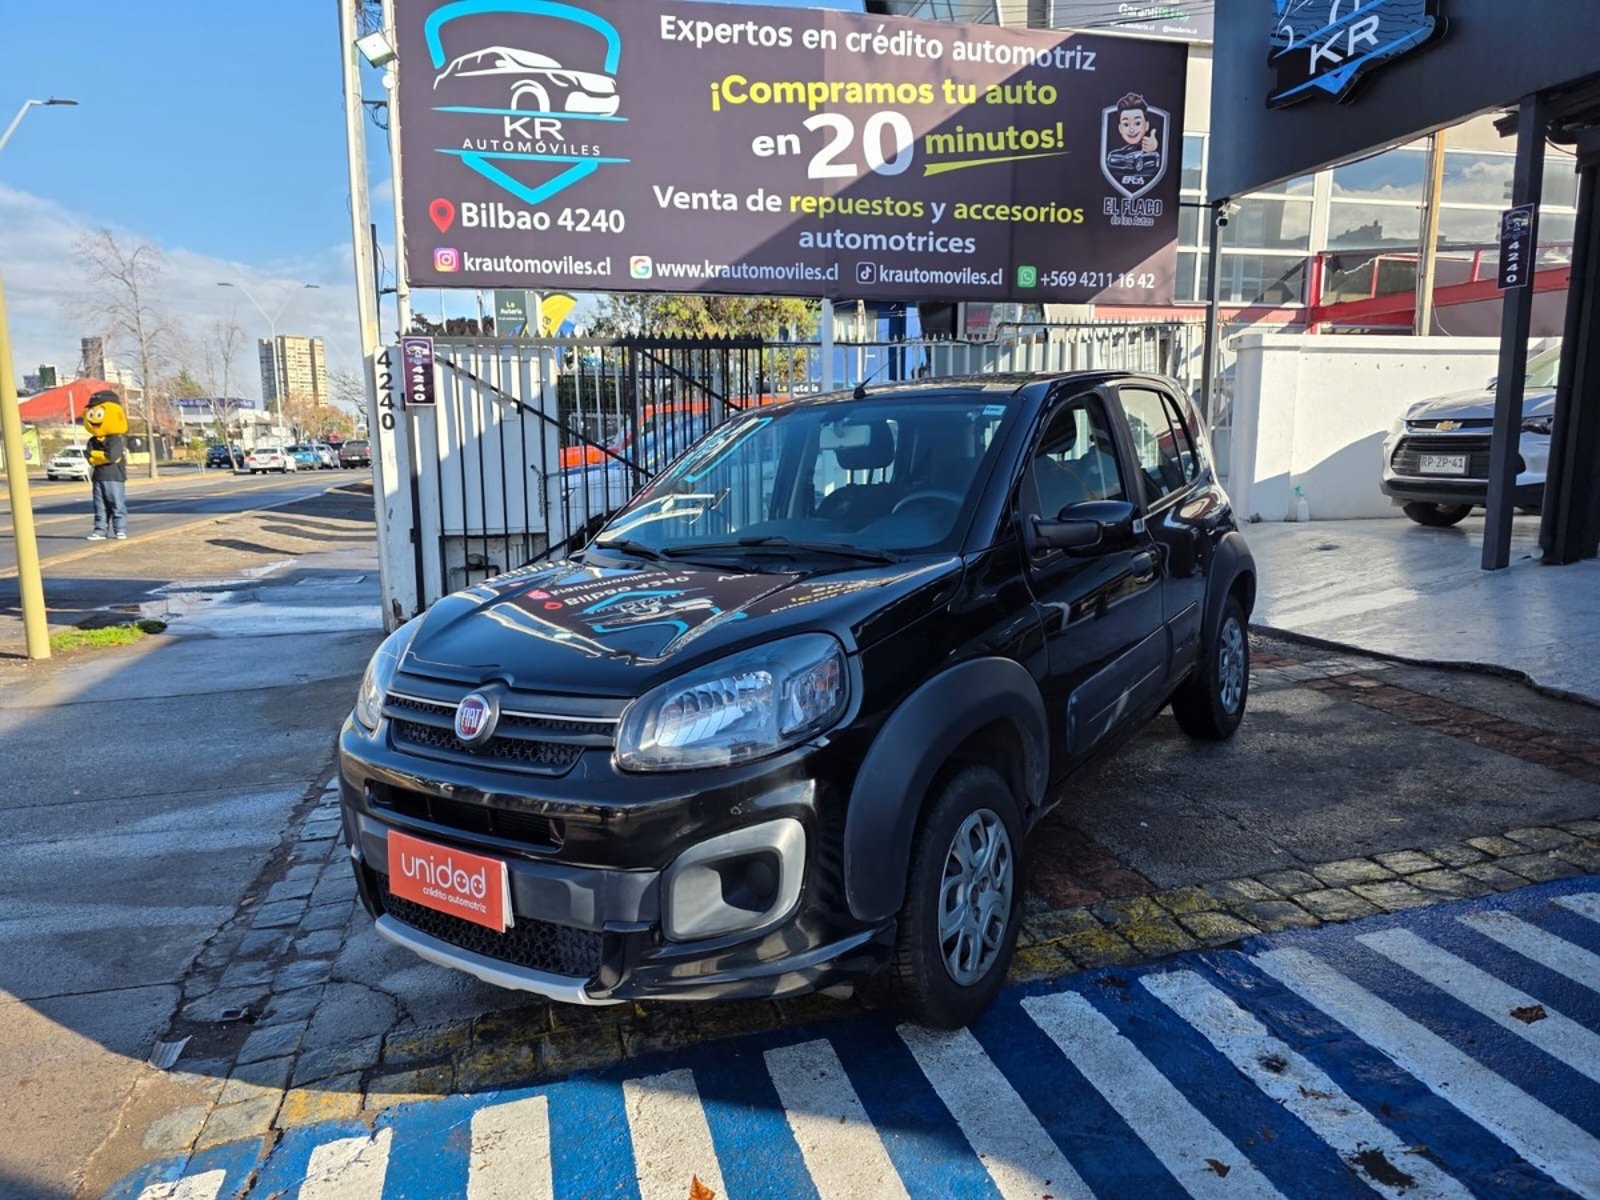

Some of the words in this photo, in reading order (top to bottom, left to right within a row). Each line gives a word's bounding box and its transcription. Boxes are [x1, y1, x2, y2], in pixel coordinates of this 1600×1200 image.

[660, 15, 793, 48] Expertos
[802, 28, 837, 50] en
[845, 24, 944, 59] crédito
[952, 40, 1097, 71] automotriz
[1309, 15, 1380, 75] KR
[710, 74, 935, 111] ¡Compramos
[942, 78, 977, 104] tu
[985, 80, 1057, 105] auto
[503, 116, 565, 141] KR
[462, 138, 601, 156] AUTOMÓVILES
[751, 133, 801, 156] en
[802, 110, 915, 179] 20
[925, 122, 1065, 154] minutos!
[461, 202, 551, 230] Bilbao
[557, 207, 626, 233] 4240
[652, 185, 738, 210] Venta
[746, 188, 782, 212] de
[789, 195, 924, 218] repuestos
[930, 201, 947, 224] y
[953, 202, 1085, 223] accesorios
[1103, 196, 1120, 215] EL
[1121, 197, 1163, 217] FLACO
[798, 229, 977, 254] automotrices
[463, 252, 611, 275] krautomoviles.cl
[656, 260, 839, 281] www.krautomoviles.cl
[879, 266, 1003, 286] krautomoviles.cl
[1505, 240, 1520, 284] 4240
[1040, 272, 1077, 288] +569
[1079, 271, 1113, 288] 4211
[1117, 272, 1135, 288] 16
[1137, 272, 1156, 289] 42
[377, 350, 396, 431] 4240
[412, 366, 426, 401] 4240
[462, 707, 483, 728] FIAT
[401, 852, 487, 899] unidad
[422, 886, 447, 901] crédito
[447, 894, 487, 914] automotriz
